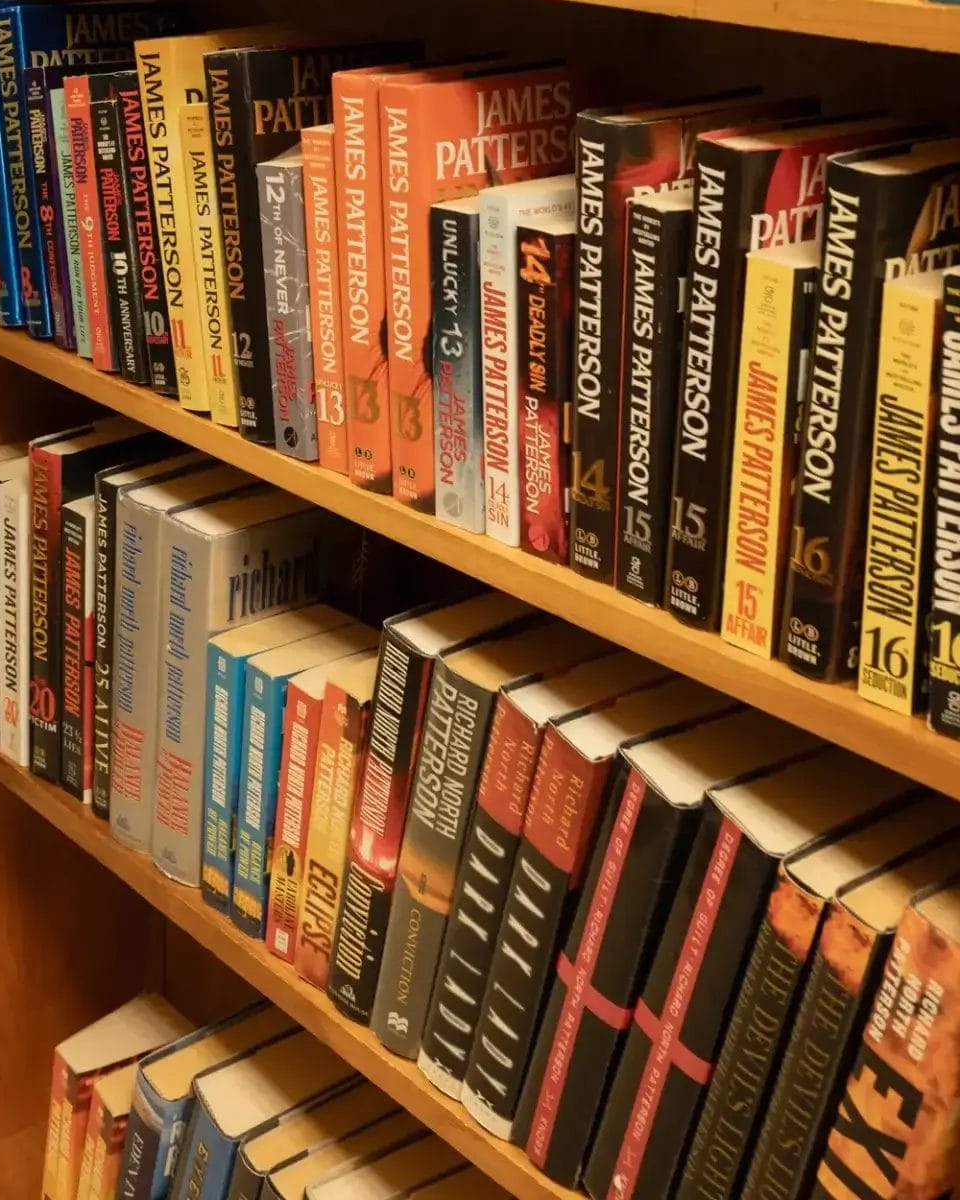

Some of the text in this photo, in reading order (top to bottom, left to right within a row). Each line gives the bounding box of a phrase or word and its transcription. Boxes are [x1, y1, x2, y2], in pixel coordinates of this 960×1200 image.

[120, 90, 159, 301] JAMES PATTERSON
[140, 52, 183, 308] JAMES PATTERSON
[189, 150, 223, 350] JAMES PATTERSON
[208, 68, 245, 300] JAMES PATTERSON
[340, 96, 370, 346] JAMES PATTERSON
[385, 105, 414, 362] JAMES PATTERSON
[87, 250, 100, 315] JUDGMENT
[310, 176, 336, 374] JAMES PATTERSON
[440, 219, 463, 357] UNLUCKY 13
[483, 280, 508, 352] JAMES
[528, 294, 548, 393] DEADLY SIN
[576, 137, 605, 422] JAMES PATTERSON
[680, 162, 725, 462] JAMES PATTERSON
[802, 187, 860, 503] JAMES PATTERSON
[317, 388, 345, 426] 13
[483, 356, 509, 476] PATTERSON
[524, 395, 539, 514] PATTERSON
[627, 250, 655, 505] JAMES PATTERSON
[734, 360, 778, 575] JAMES PATTERSON
[867, 393, 925, 627] JAMES PATTERSON
[63, 546, 81, 717] JAMES PATTERSON
[94, 493, 110, 776] JAMES PATTERSON 25 ALIVE
[117, 522, 143, 714] richard north patterson
[165, 545, 192, 744] richard north patterson
[726, 615, 769, 651] AFFAIR
[281, 722, 308, 849] RICHARD NORTH PATTERSON
[335, 642, 410, 981] RICHARD NORTH PATTERSON Conviction
[412, 676, 458, 830] PATTERSON
[436, 691, 480, 840] RICHARD NORTH
[508, 739, 536, 818] Richard
[540, 767, 565, 825] North
[555, 773, 585, 851] Richard
[300, 859, 338, 961] ECLIPSE
[395, 907, 422, 1007] CONVICTION
[436, 825, 506, 1066] DARK LADY
[475, 857, 551, 1096] DARK LADY
[631, 832, 735, 1140] DEGREE OF GUILT RICHARD NORTH PATTERSON
[867, 937, 911, 1044] PATTERSON
[776, 972, 849, 1157] THE DEVIL'S
[892, 972, 924, 1038] NORTH
[906, 978, 944, 1062] RICHARD
